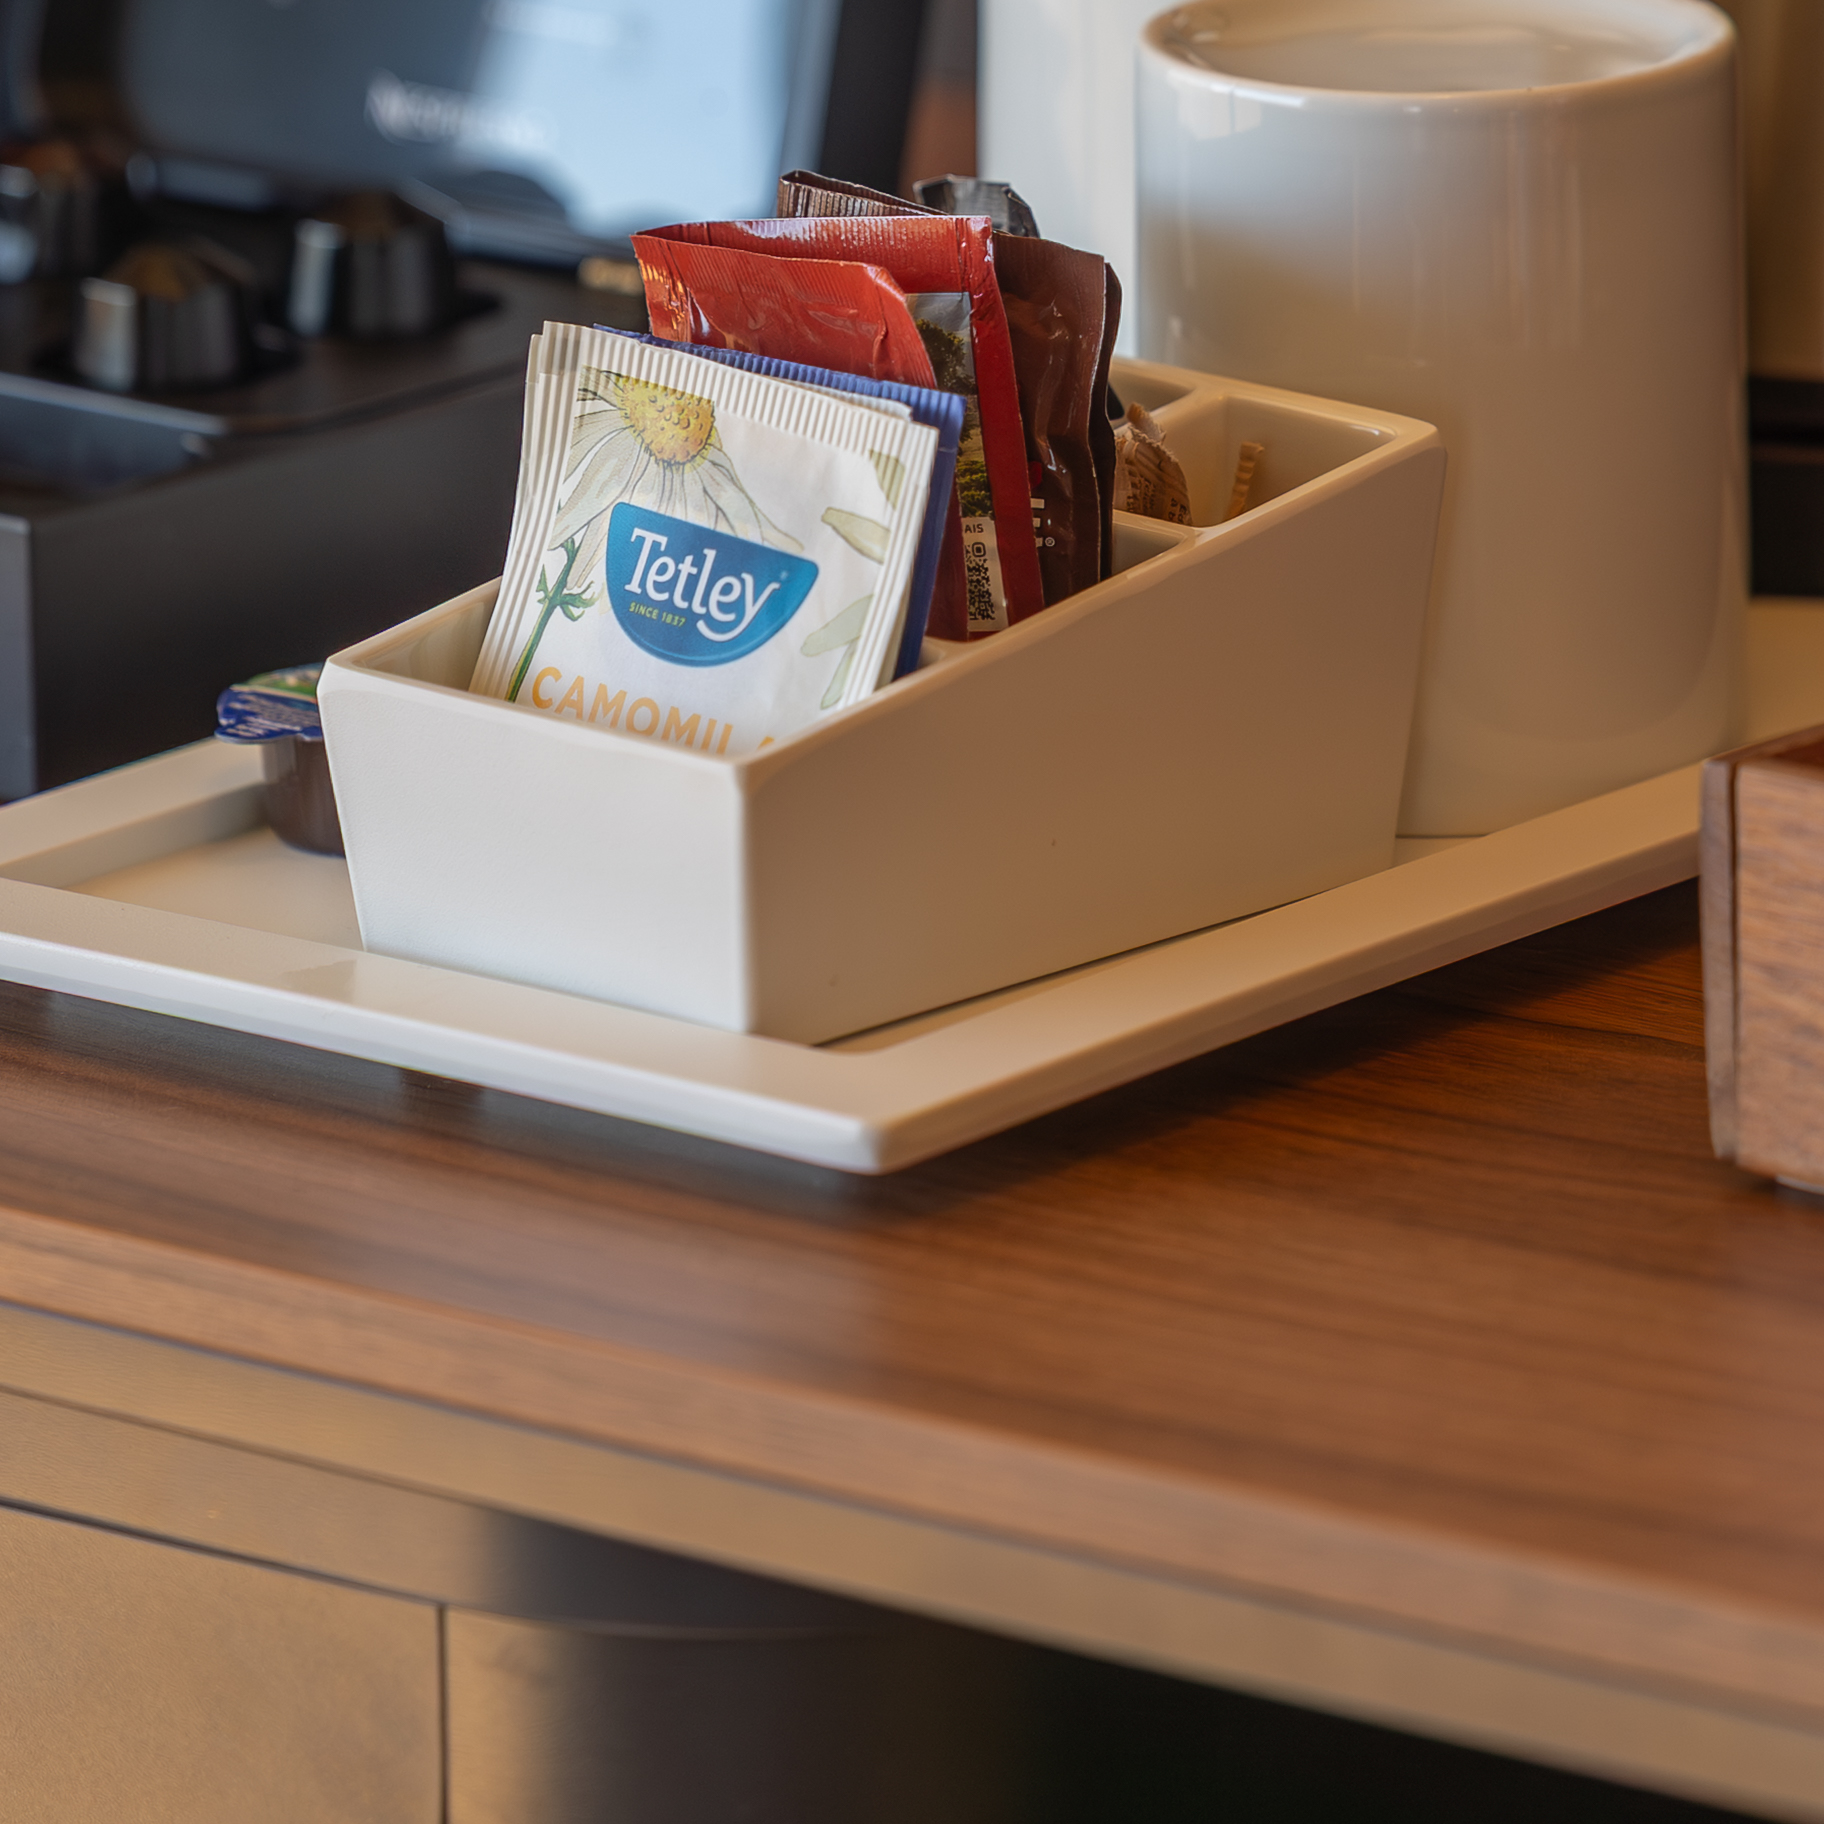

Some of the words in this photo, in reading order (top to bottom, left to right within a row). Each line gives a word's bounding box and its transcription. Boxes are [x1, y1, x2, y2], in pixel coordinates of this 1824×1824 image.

[963, 523, 985, 535] AIS
[623, 527, 781, 643] Tetley
[628, 601, 660, 621] SINCE
[661, 611, 687, 628] 1837
[530, 665, 775, 756] CAMOMIL
